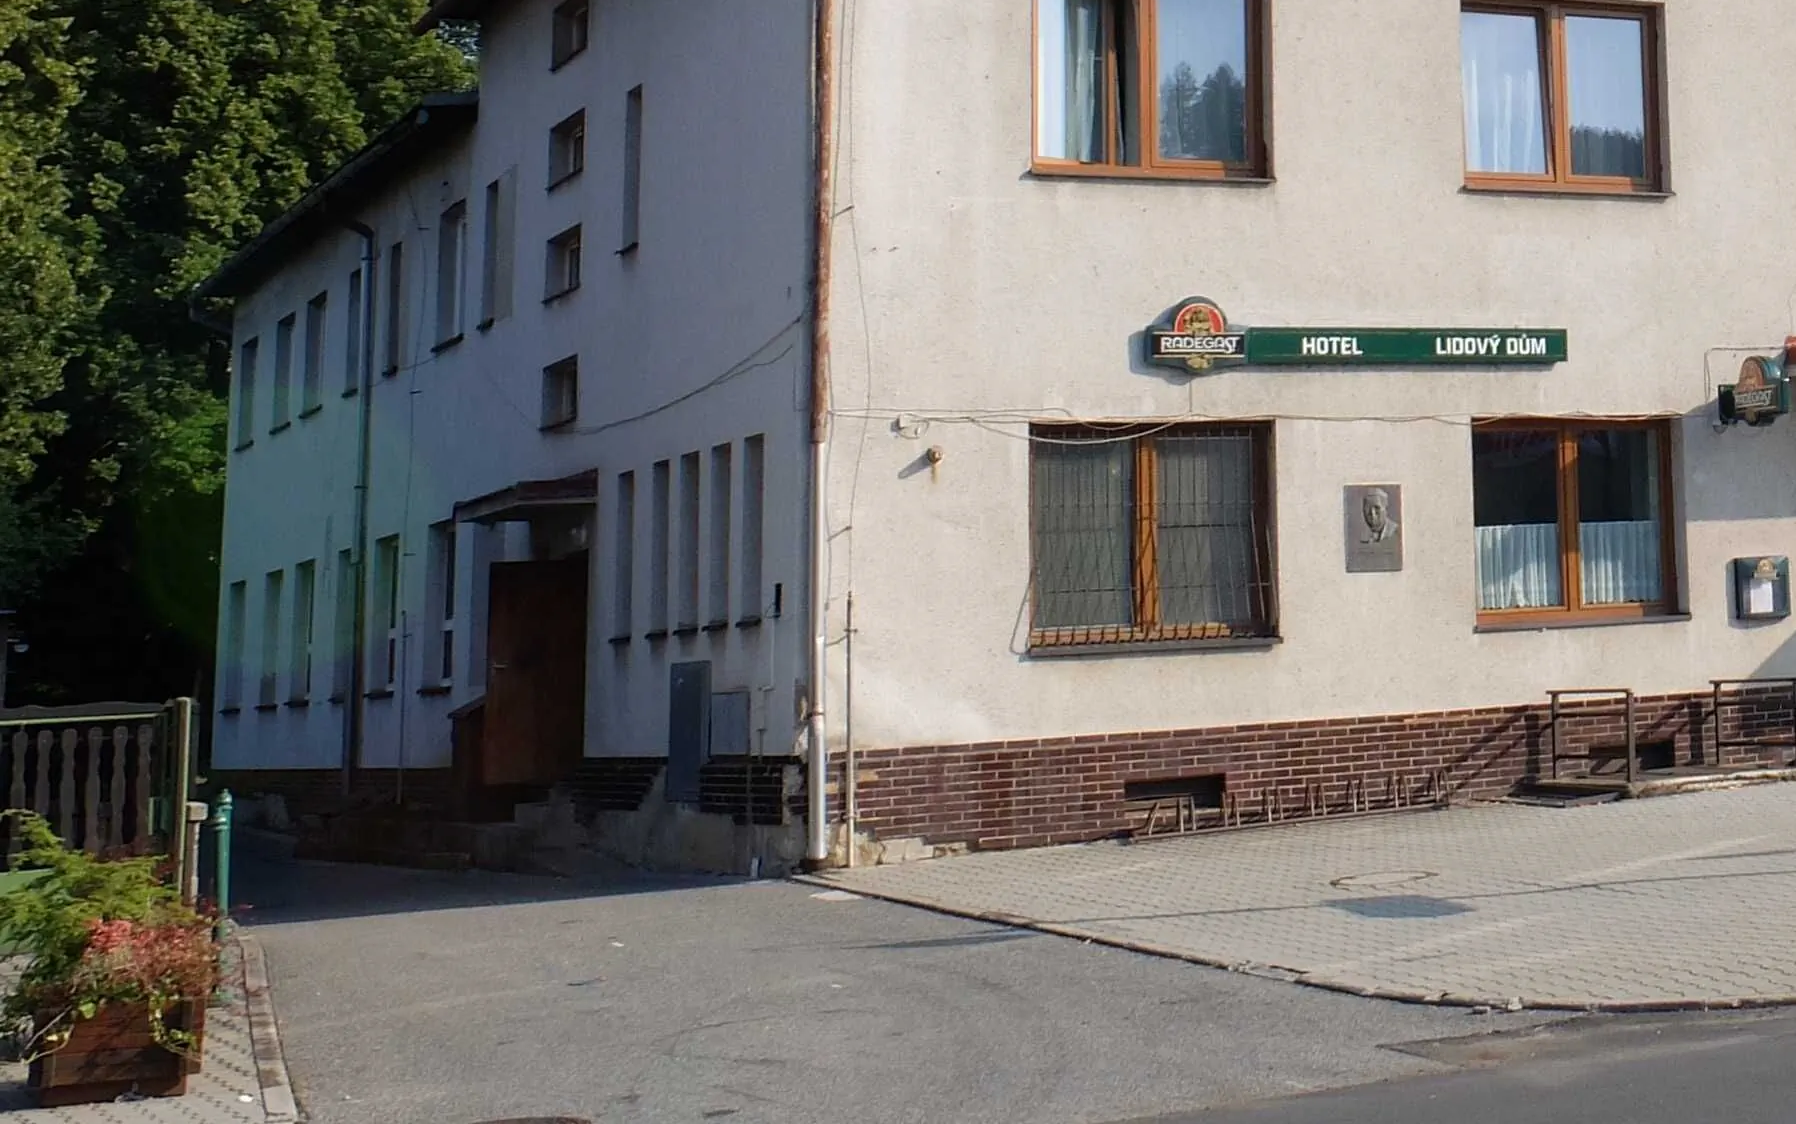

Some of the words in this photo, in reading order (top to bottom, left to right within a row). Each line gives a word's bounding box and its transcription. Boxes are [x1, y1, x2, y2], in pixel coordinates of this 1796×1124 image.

[1160, 336, 1240, 354] RADEGAST
[1302, 336, 1363, 355] HOTEL
[1436, 334, 1501, 355] LIDOVÝ
[1506, 333, 1546, 355] DŮM
